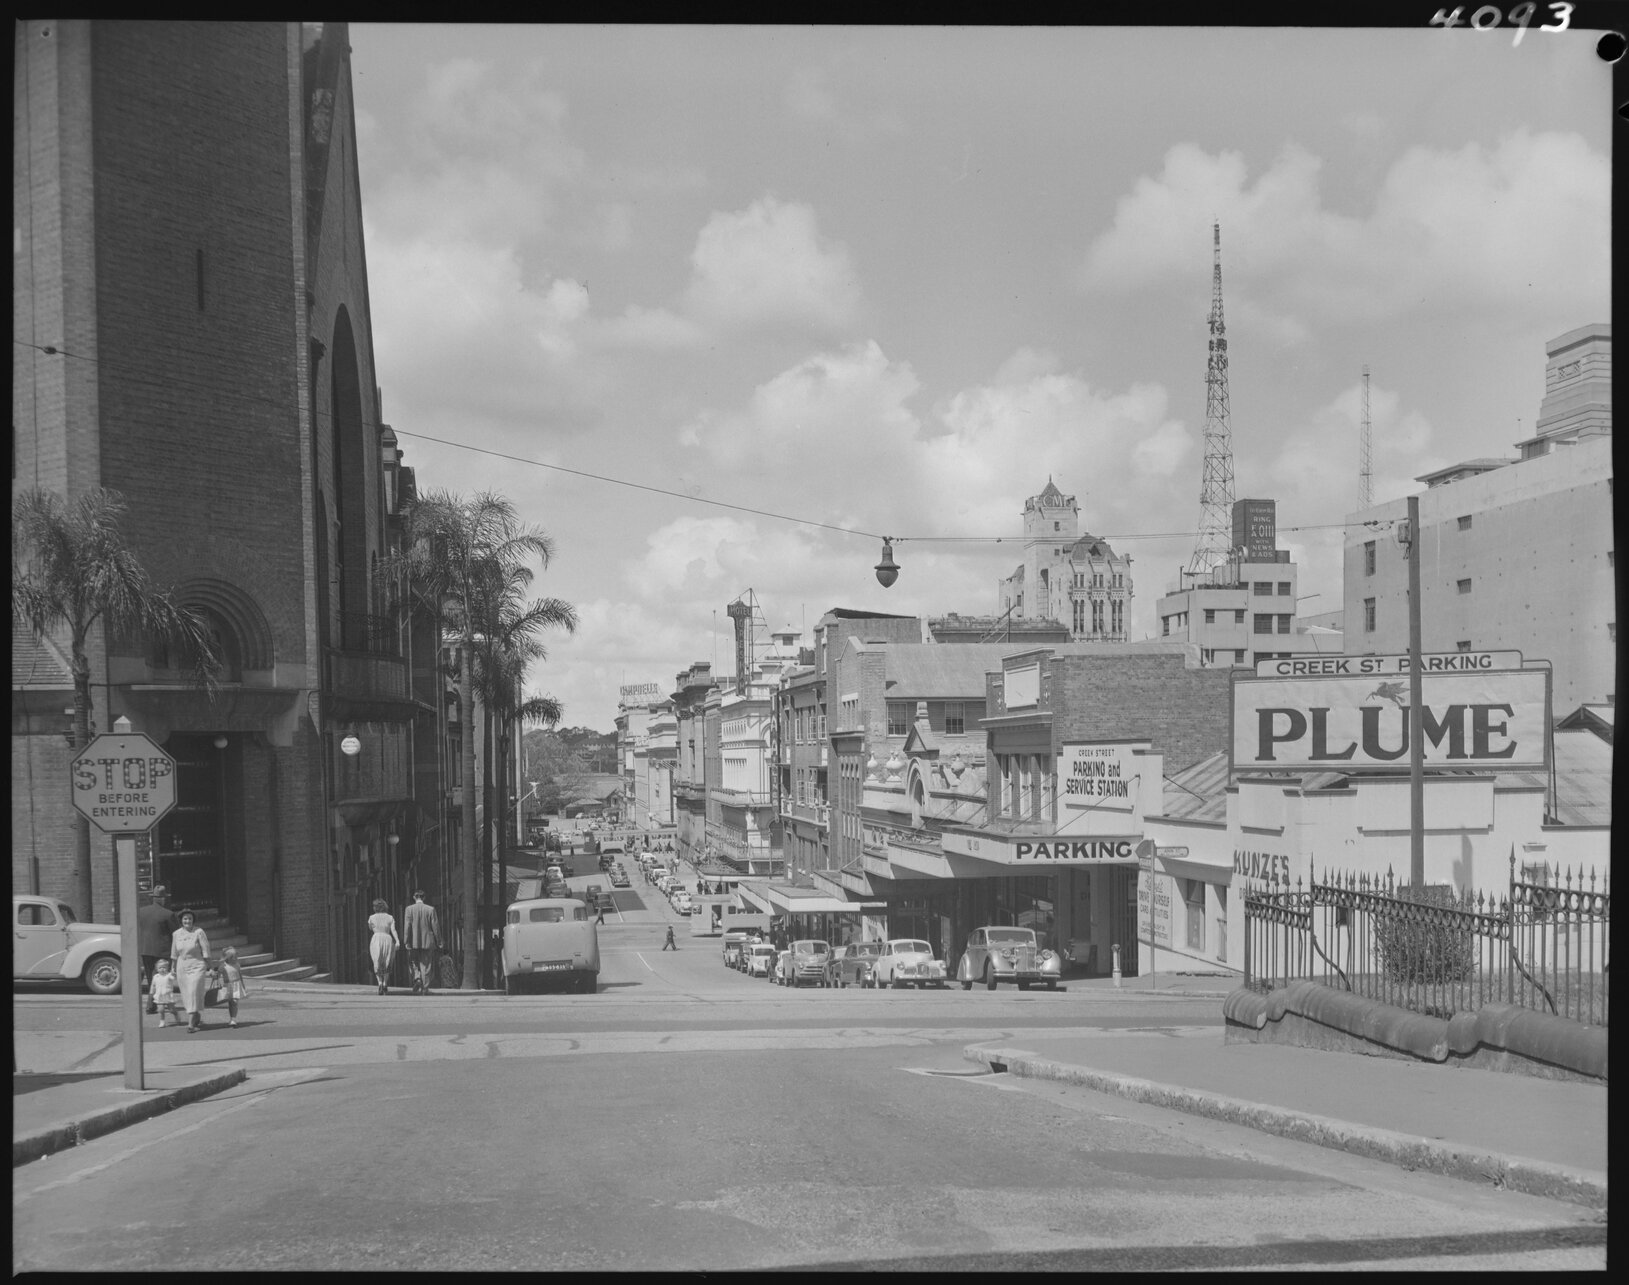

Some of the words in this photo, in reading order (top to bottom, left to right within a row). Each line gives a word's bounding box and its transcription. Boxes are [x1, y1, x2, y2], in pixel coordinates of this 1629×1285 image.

[1276, 659, 1350, 675] CREEK
[1360, 659, 1383, 673] ST
[1399, 655, 1492, 673] PARKING
[1254, 704, 1517, 762] PLUME
[74, 758, 171, 790] STOP
[1073, 761, 1105, 777] PARKING
[1108, 760, 1121, 777] and
[99, 793, 149, 803] BEFORE
[1066, 779, 1094, 795] SERVICE
[1097, 780, 1128, 798] STATION
[92, 807, 156, 817] ENTERING
[1016, 841, 1132, 859] PARKING
[1233, 849, 1290, 885] KUNZE'S
